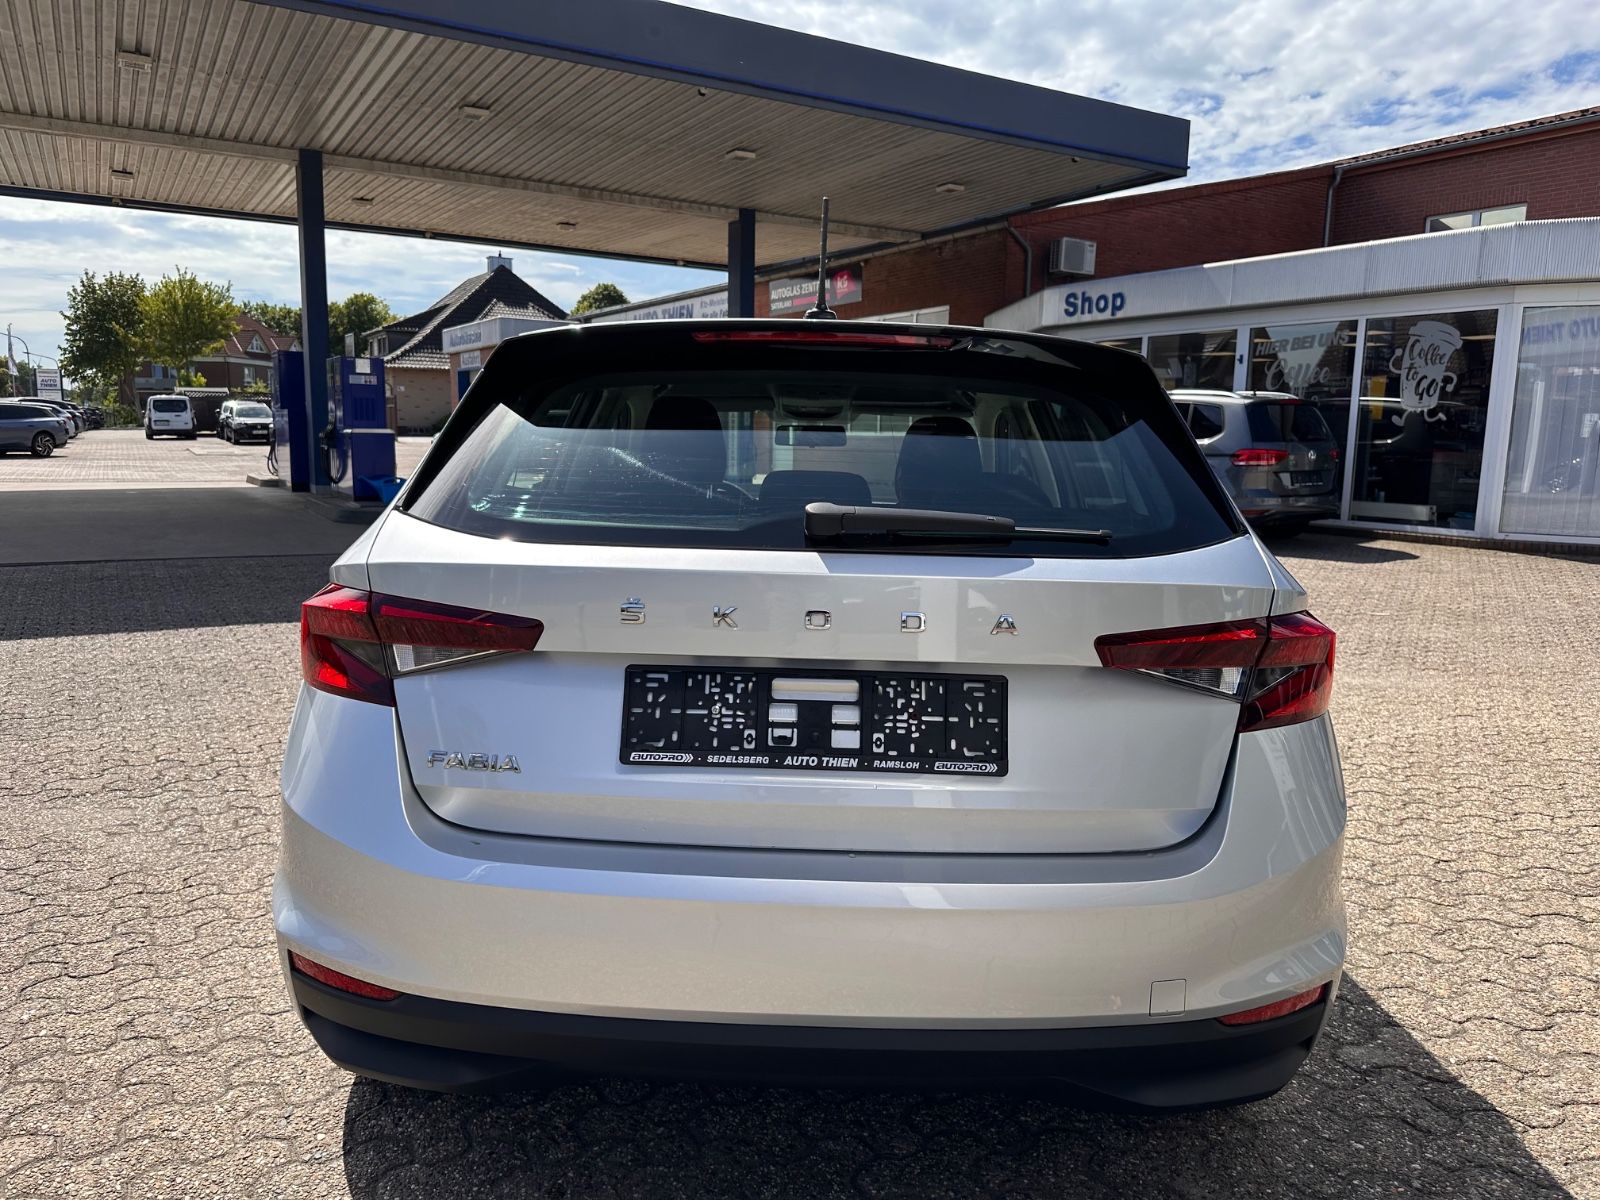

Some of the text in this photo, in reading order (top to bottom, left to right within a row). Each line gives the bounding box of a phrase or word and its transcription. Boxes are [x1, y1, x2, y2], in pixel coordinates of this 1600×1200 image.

[771, 279, 830, 300] AUTOGLAS ZENTM
[1064, 291, 1126, 317] Shop
[1255, 329, 1350, 356] HIER BEI UNS
[1408, 339, 1447, 366] Coffee
[1404, 362, 1419, 382] to
[427, 750, 522, 773] FABIA
[706, 755, 769, 764] SEDELSBERG
[784, 756, 818, 767] AUTO
[821, 756, 859, 768] THIEN
[873, 760, 920, 770] RAMSLOH
